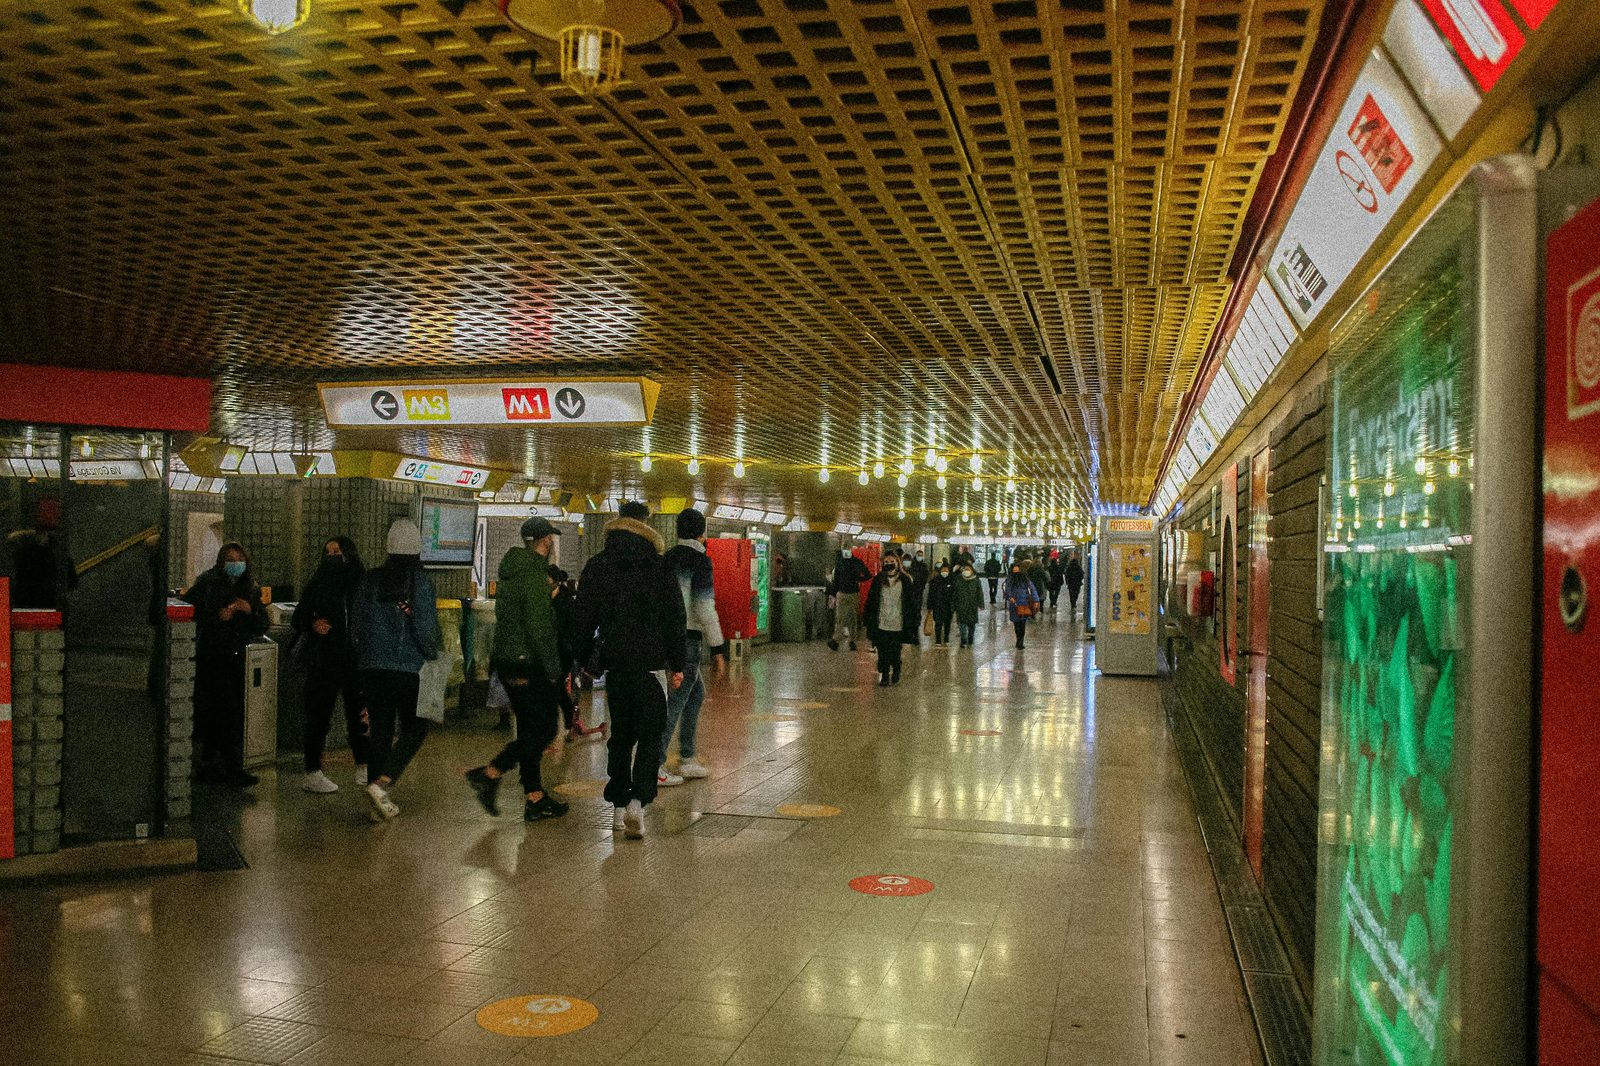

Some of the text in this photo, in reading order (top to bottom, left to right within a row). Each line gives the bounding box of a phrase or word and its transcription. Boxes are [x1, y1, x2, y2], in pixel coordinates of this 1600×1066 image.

[409, 395, 446, 415] M3
[508, 393, 544, 414] M1
[1110, 520, 1152, 530] FOTOTESSERA
